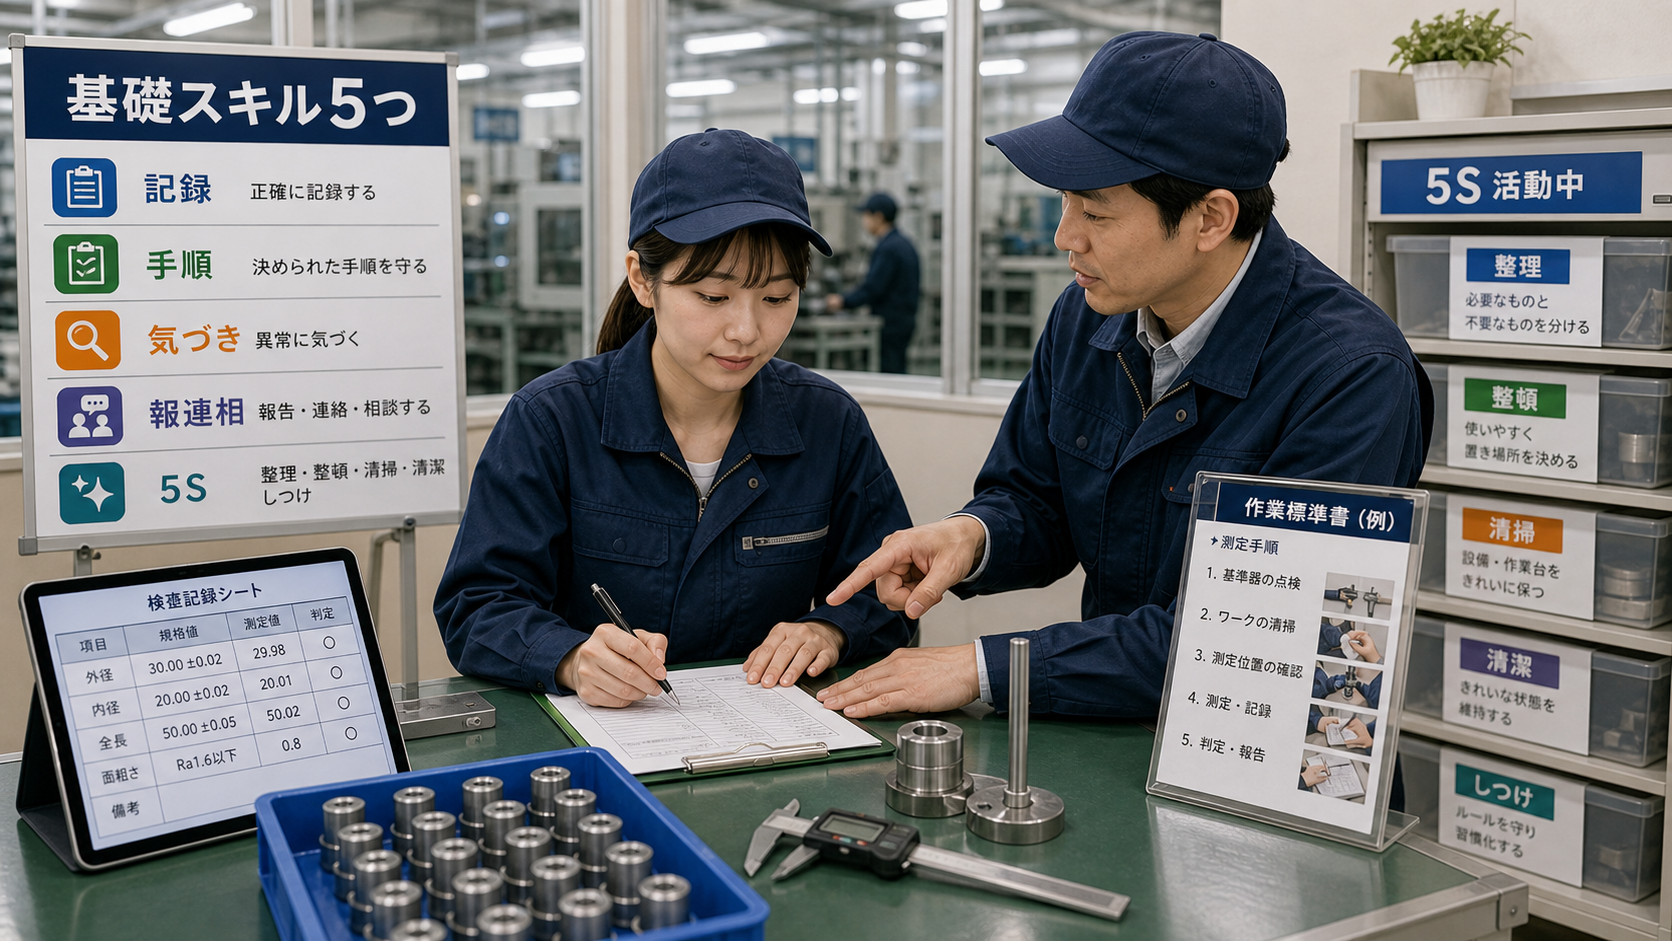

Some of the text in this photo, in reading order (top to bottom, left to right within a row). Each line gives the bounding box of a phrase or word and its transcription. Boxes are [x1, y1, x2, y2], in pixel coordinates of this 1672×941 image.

[67, 74, 416, 129] 基礎スキル5つ
[144, 174, 375, 204] 記録 正確に記録する
[1426, 166, 1583, 204] 5S 活動中
[147, 250, 426, 280] 手順 決められた手順を守る
[1495, 254, 1541, 278] 整理
[1466, 292, 1548, 309] 必要なものと
[148, 324, 358, 355] 気づき 異常に気づく
[1466, 316, 1589, 334] 不要なものを分ける
[1492, 385, 1538, 411] 整頓
[150, 397, 430, 429] 報連相 報告・連絡・相談する
[1465, 422, 1531, 441] 使いやすく
[1465, 444, 1578, 470] 置き場所を決める
[161, 459, 444, 503] 5S 整理・整頓・清掃・清潔
[265, 488, 311, 505] しつけ
[1221, 535, 1279, 555] 測定手順
[1490, 517, 1535, 544] 清掃
[1208, 567, 1301, 590] 1. 基準器の点検
[1463, 551, 1559, 579] 設備・作業台を
[1462, 574, 1544, 599] きれいに保つ
[79, 607, 334, 652] 項目 規格値 測定値 判定
[1201, 608, 1295, 633] 2. ワークの清掃
[86, 669, 113, 684] 外径
[149, 659, 183, 674] 30.00
[187, 653, 222, 668] ±0.02
[253, 644, 285, 659] 29.98
[1195, 649, 1303, 678] 3. 測定位置の確認
[1486, 649, 1531, 678] 清潔
[92, 701, 120, 717] 内径
[155, 691, 190, 707] 20.00
[194, 685, 229, 700] ±0.02
[260, 675, 291, 690] 20.01
[1188, 692, 1271, 718] 4. 測定・記録
[1459, 680, 1556, 714] きれいな状態を
[99, 733, 127, 750] 全長
[163, 723, 197, 739] 50.00
[201, 716, 236, 732] ±0.05
[267, 706, 300, 721] 50.02
[1459, 702, 1511, 726] 維持する
[102, 767, 138, 784] 面粗さ
[177, 749, 236, 773] Ra1.6以下
[282, 738, 301, 751] 0.8
[1182, 733, 1265, 762] 5. 判定・報告
[1474, 774, 1534, 809] しつけ
[112, 801, 139, 819] 備考
[1457, 805, 1536, 840] ルールを守り
[1455, 825, 1523, 858] 習慣化する
